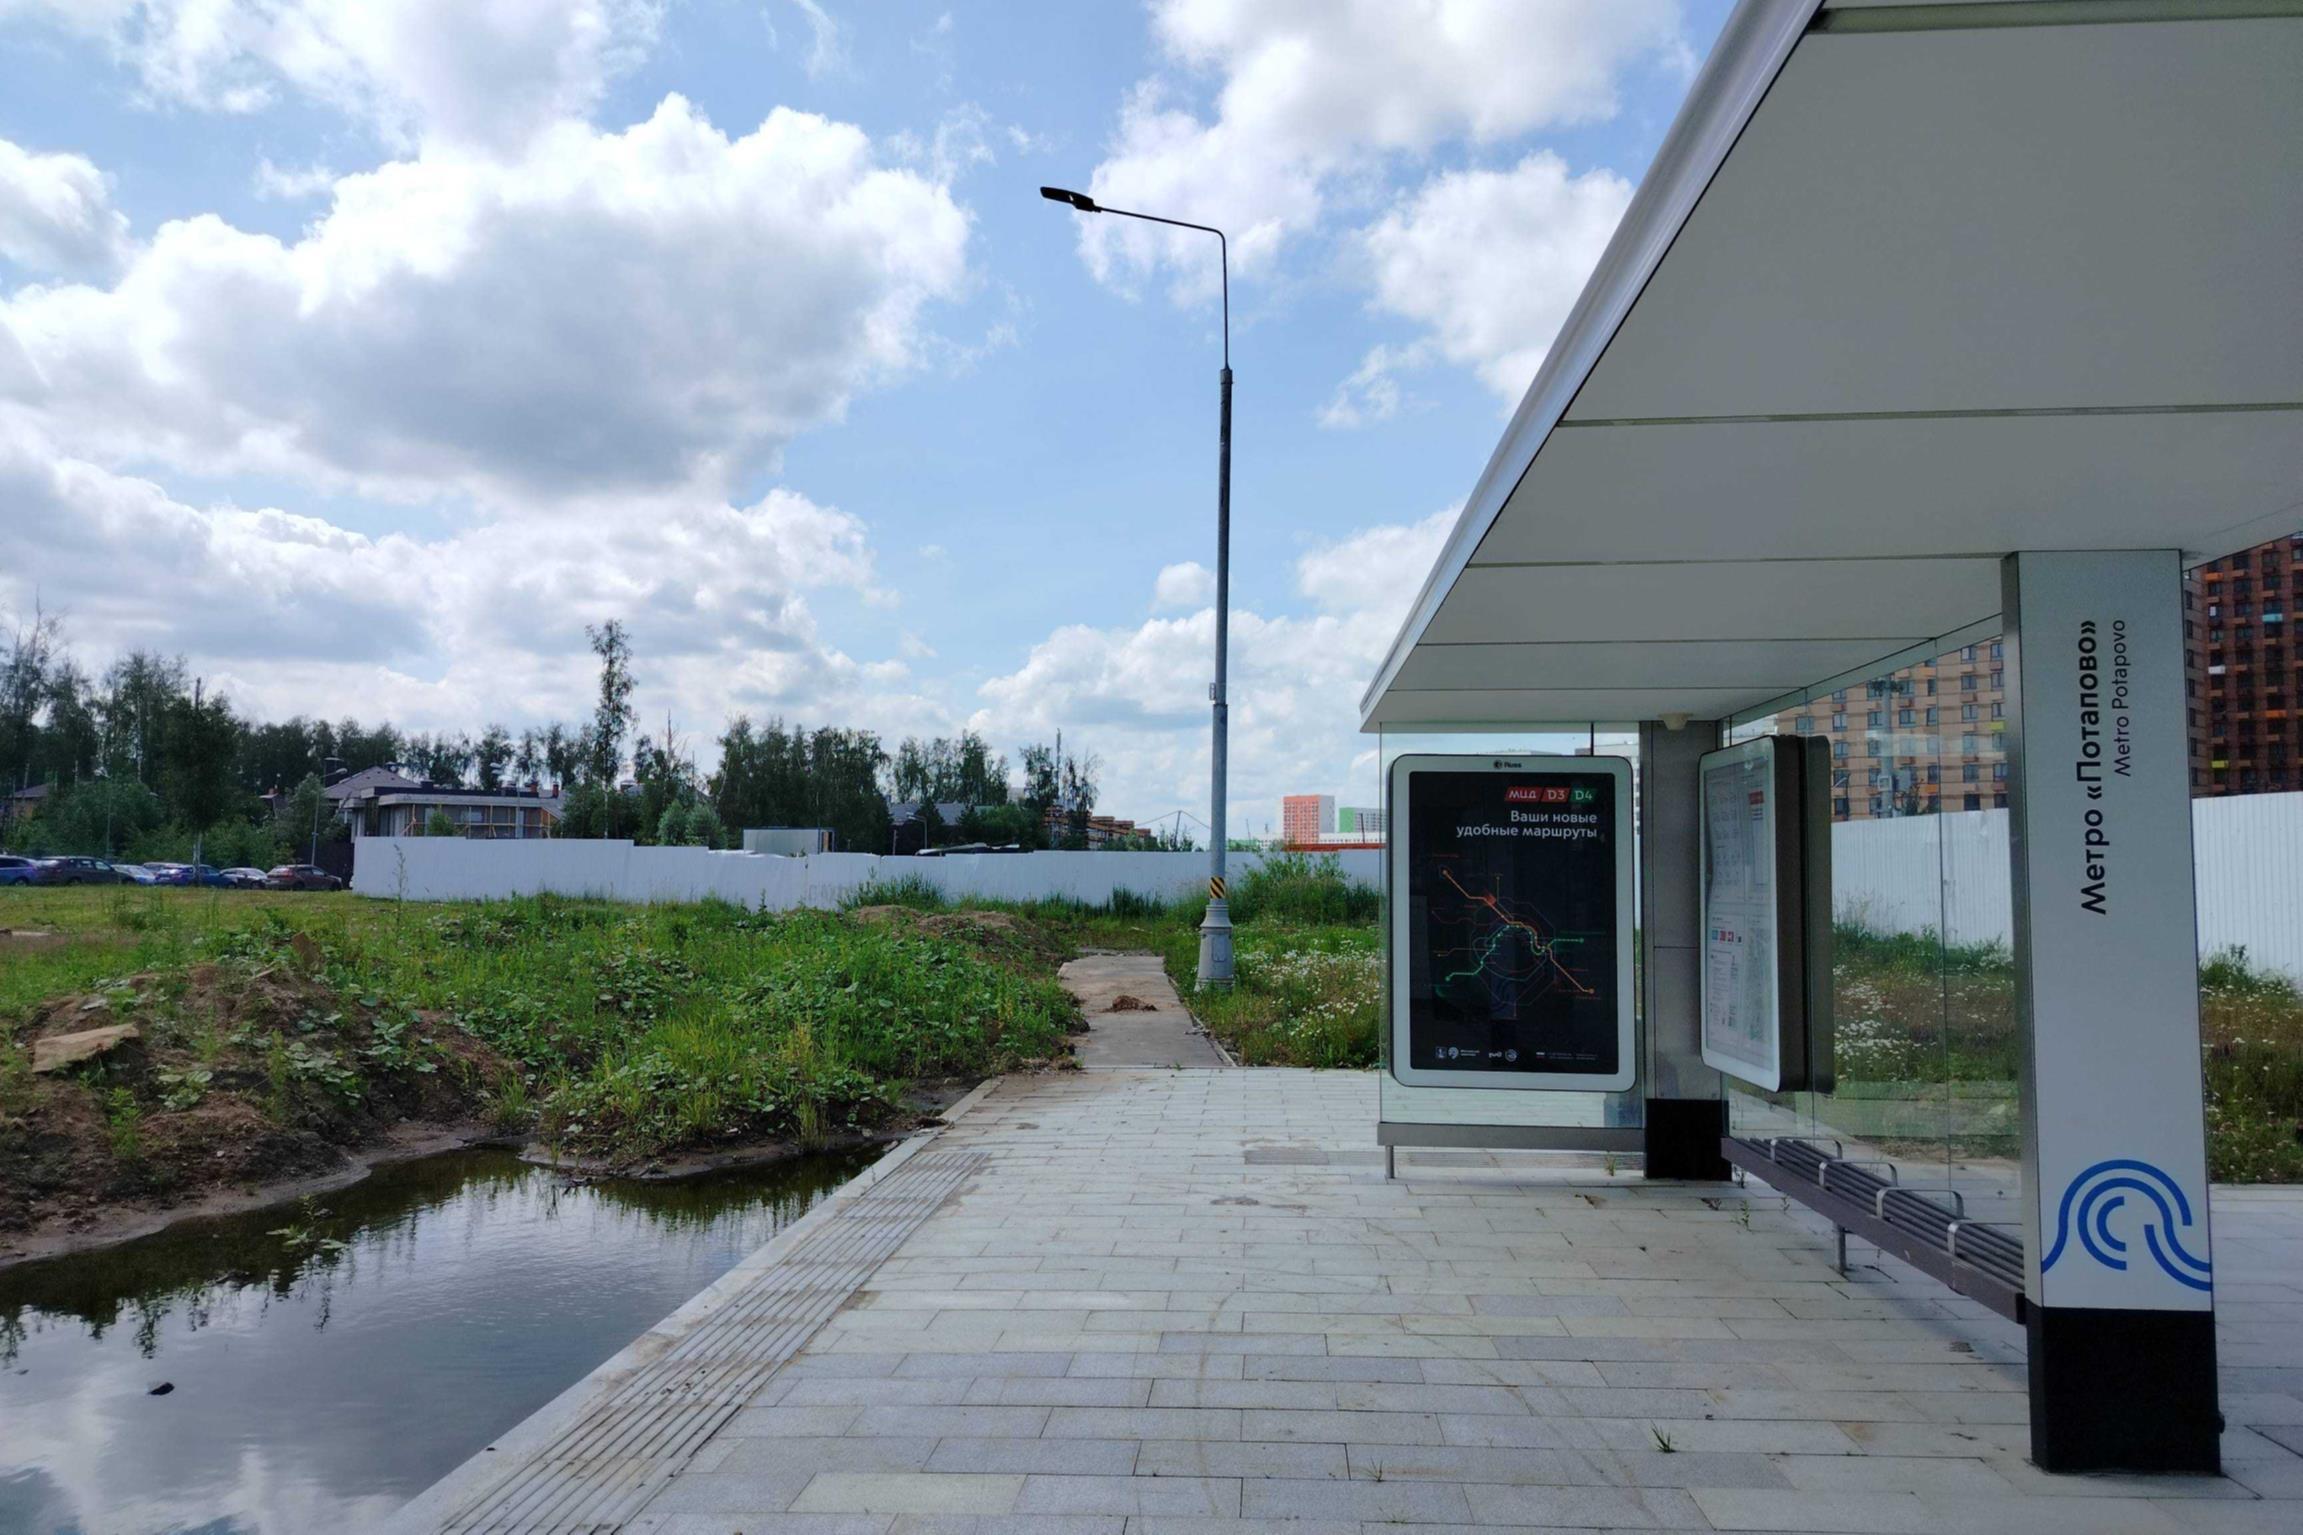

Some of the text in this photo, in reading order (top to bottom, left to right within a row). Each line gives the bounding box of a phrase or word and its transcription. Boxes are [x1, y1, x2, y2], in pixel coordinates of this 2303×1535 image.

[2112, 619, 2131, 777] Metro Potapovo
[2077, 620, 2109, 915] Метро «Потапово»
[1547, 790, 1565, 800] D3
[1575, 790, 1593, 801] D4
[1511, 810, 1598, 823] Ваши новые
[1456, 824, 1597, 840] удобные маршруты
